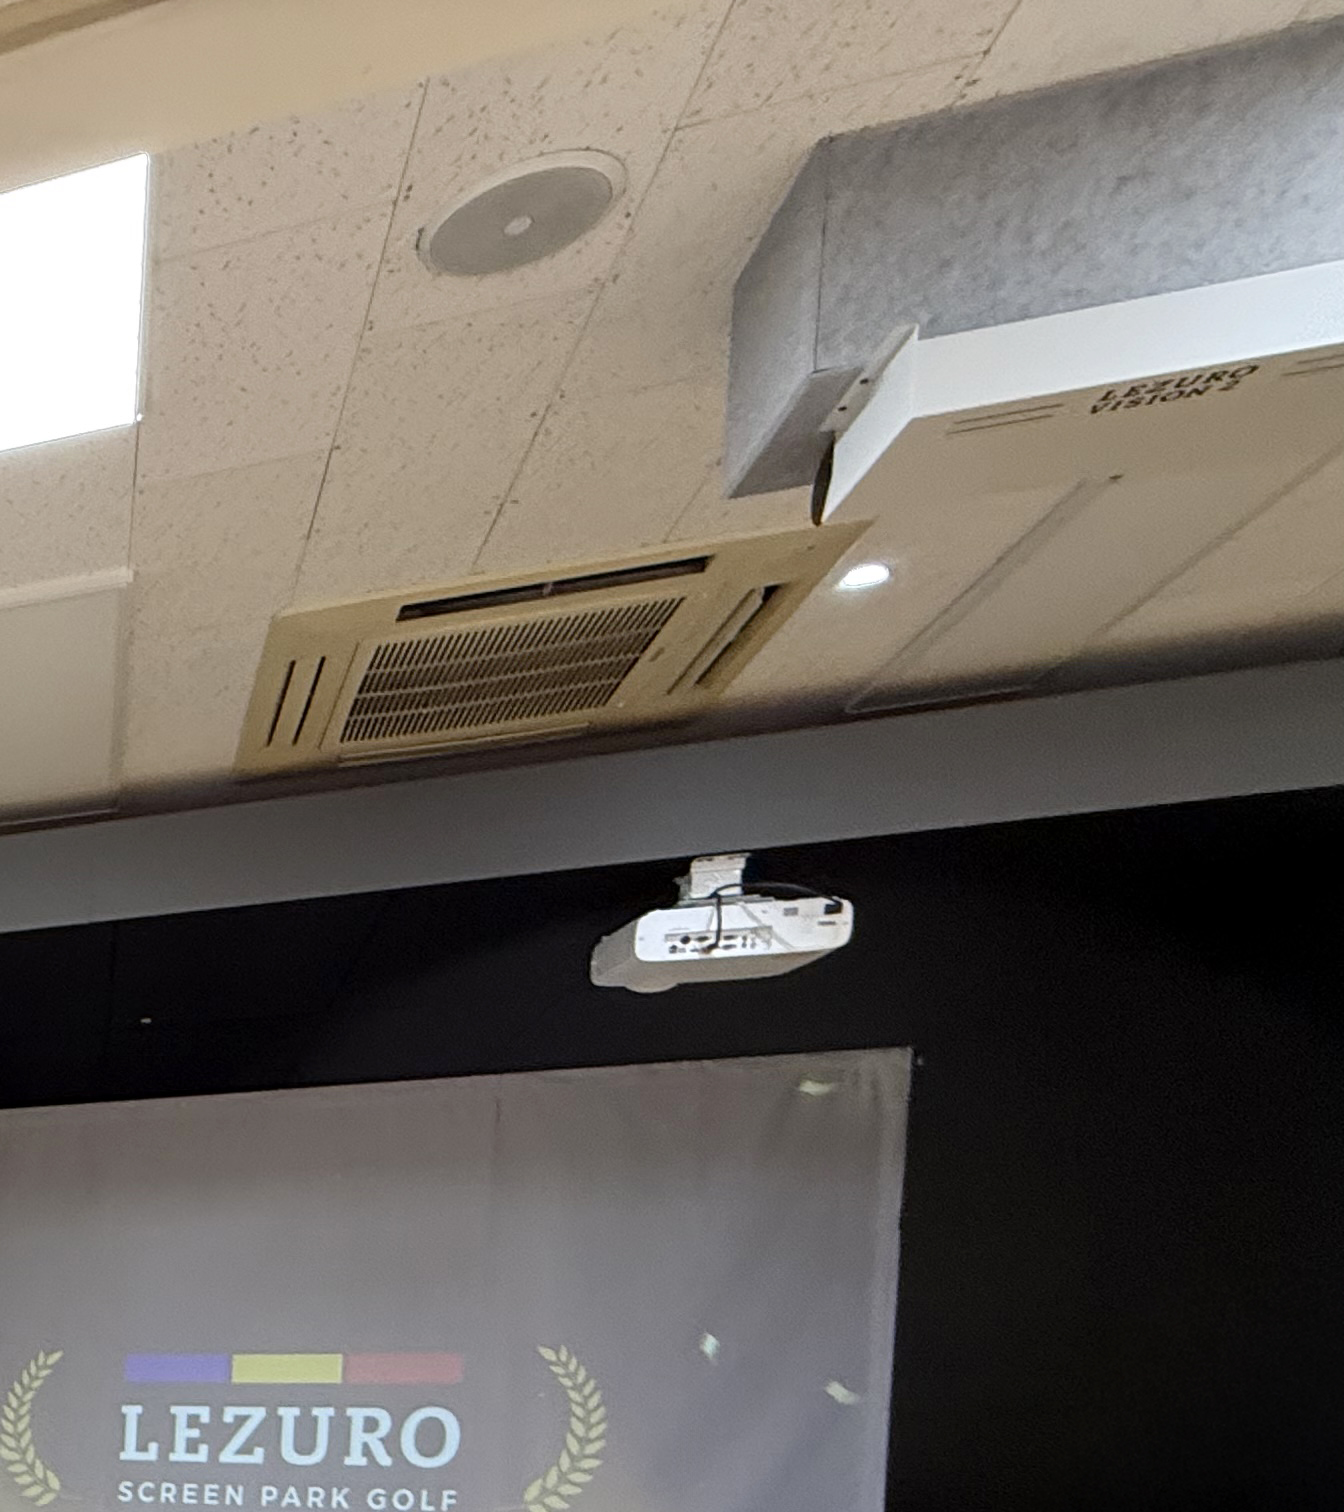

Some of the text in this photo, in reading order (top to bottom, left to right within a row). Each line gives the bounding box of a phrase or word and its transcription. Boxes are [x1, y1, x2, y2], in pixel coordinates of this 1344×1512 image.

[1089, 384, 1213, 415] VISION
[1098, 364, 1260, 403] LEZURO
[118, 1403, 462, 1469] LEZURO
[117, 1480, 458, 1512] SCREEN PARK GOLF
